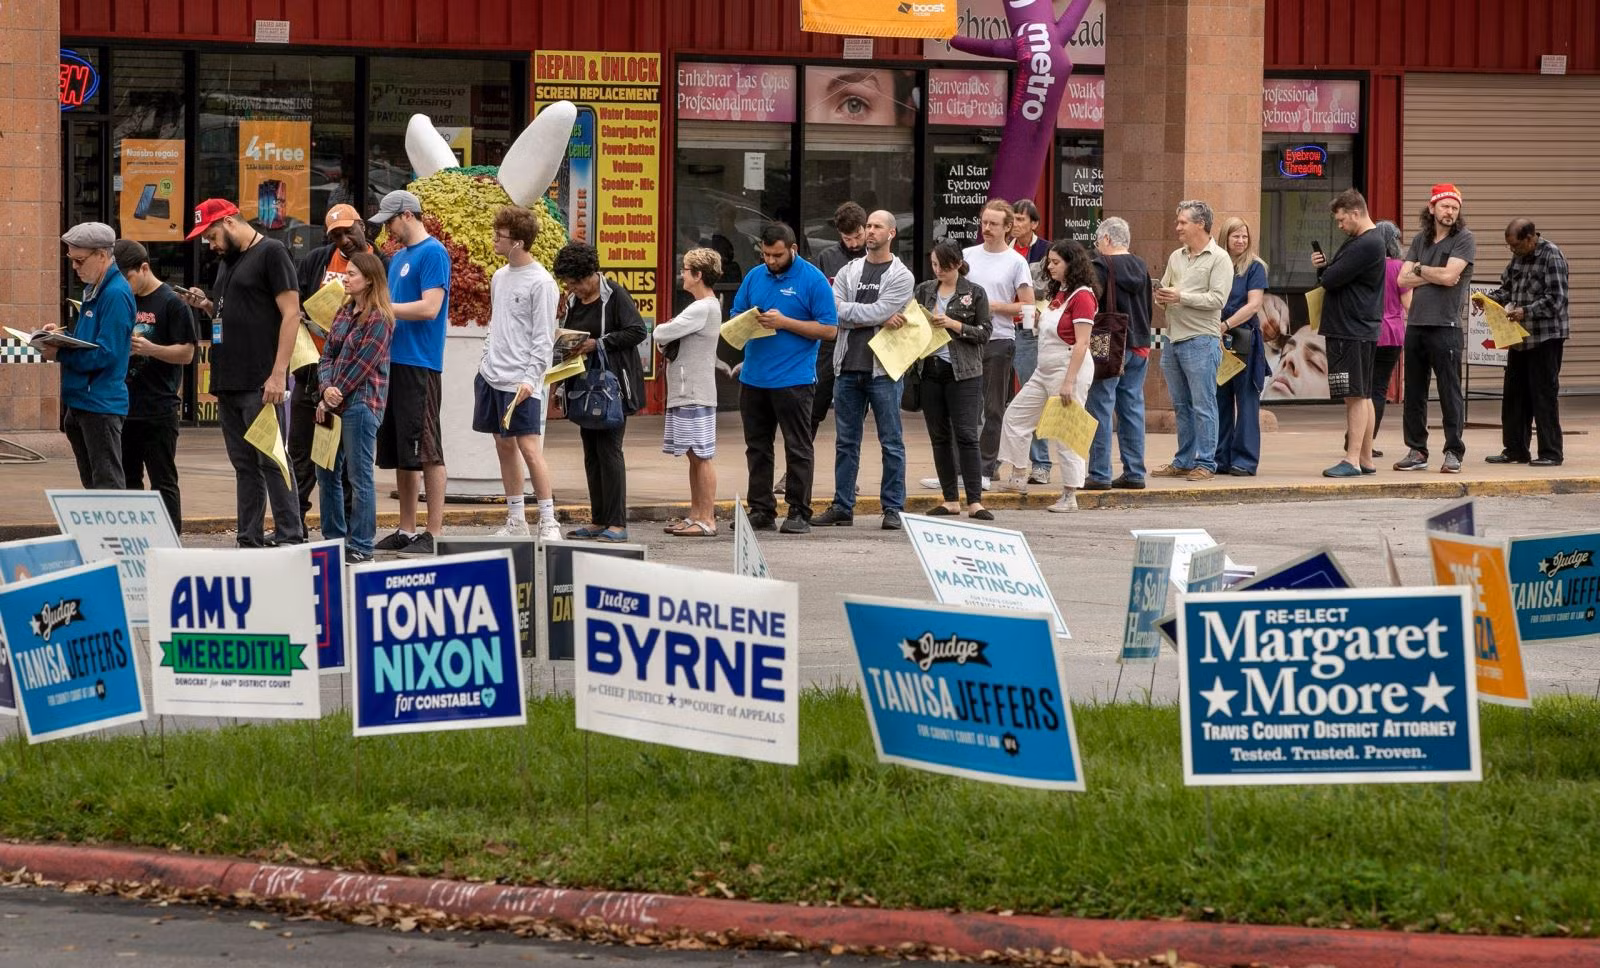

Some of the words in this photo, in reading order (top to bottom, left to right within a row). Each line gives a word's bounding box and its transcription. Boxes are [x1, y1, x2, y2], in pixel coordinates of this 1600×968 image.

[912, 3, 945, 12] boost
[536, 55, 586, 80] REPAIR
[588, 59, 599, 81] &
[601, 56, 659, 82] UNLOCK
[1021, 22, 1056, 121] metro
[678, 69, 733, 88] Enhebrar
[736, 72, 758, 89] Las
[928, 78, 990, 96] Bienvenidos
[385, 84, 466, 97] Progressive
[536, 86, 578, 99] SCREEN
[579, 87, 658, 101] REPLACEMENT
[1068, 82, 1097, 99] Walk
[1262, 85, 1318, 106] rofessional
[398, 96, 452, 109] Leasing
[677, 91, 776, 115] Profesionalmente
[928, 98, 943, 114] Sin
[947, 98, 967, 115] Cita
[970, 98, 1004, 119] Previa
[600, 107, 624, 120] Water
[625, 107, 658, 122] Damage
[1304, 107, 1357, 129] Threading
[601, 124, 638, 139] Charging
[639, 125, 656, 138] Port
[155, 149, 179, 159] regalo
[245, 135, 261, 161] 4
[264, 142, 305, 162] Free
[602, 142, 627, 155] Power
[628, 142, 655, 155] Button
[1285, 149, 1322, 163] Eyebrow
[612, 160, 644, 173] Volume
[949, 165, 964, 176] All
[966, 165, 988, 176] Star
[1074, 168, 1089, 179] All
[1285, 161, 1323, 177] Threading
[601, 177, 635, 191] Speaker
[640, 177, 655, 190] Mic
[947, 180, 991, 193] Eyebrow
[611, 195, 643, 208] Camera
[602, 212, 625, 225] Home
[626, 212, 653, 225] Button
[939, 216, 967, 228] Monday
[1064, 218, 1091, 230] Monday
[600, 230, 627, 244] Google
[628, 230, 656, 243] Unlock
[948, 231, 965, 239] 10am
[966, 231, 973, 239] to
[1072, 232, 1089, 241] 10am
[622, 247, 646, 260] Break
[70, 511, 157, 525] DEMOCRAT
[922, 531, 1017, 556] DEMOCRAT
[1547, 549, 1590, 578] Judge
[385, 572, 437, 590] DEMOCRAT
[934, 569, 1045, 599] MARTINSON
[170, 575, 252, 630] AMY
[1511, 579, 1563, 610] TANISA
[41, 600, 78, 641] Judge
[366, 584, 500, 642] TONYA
[597, 590, 640, 614] Judge
[658, 595, 786, 639] DARLENE
[1265, 607, 1349, 624] RE-ELECT
[919, 632, 979, 672] Judge
[1199, 609, 1449, 680] Margaret
[15, 642, 72, 691] TANISA
[66, 628, 128, 680] JEFFERS
[177, 639, 286, 671] MEREDITH
[586, 617, 786, 703] BYRNE
[373, 635, 504, 694] NIXON
[175, 677, 208, 686] DEMOCRAT
[238, 679, 267, 688] DISTRICT
[268, 680, 291, 688] COURT
[867, 666, 958, 721] TANISA
[957, 679, 1060, 731] JEFFERS
[1240, 666, 1410, 717] Moore
[394, 693, 416, 718] for
[415, 691, 481, 709] CONSTABLE
[598, 683, 626, 698] CHIEF
[627, 689, 665, 705] JUSTICE
[692, 697, 725, 716] COURT
[727, 706, 738, 717] of
[739, 708, 786, 725] APPEALS
[1230, 746, 1287, 762] Tested.
[1291, 745, 1360, 761] Trusted.
[1363, 745, 1427, 760] Proven.
